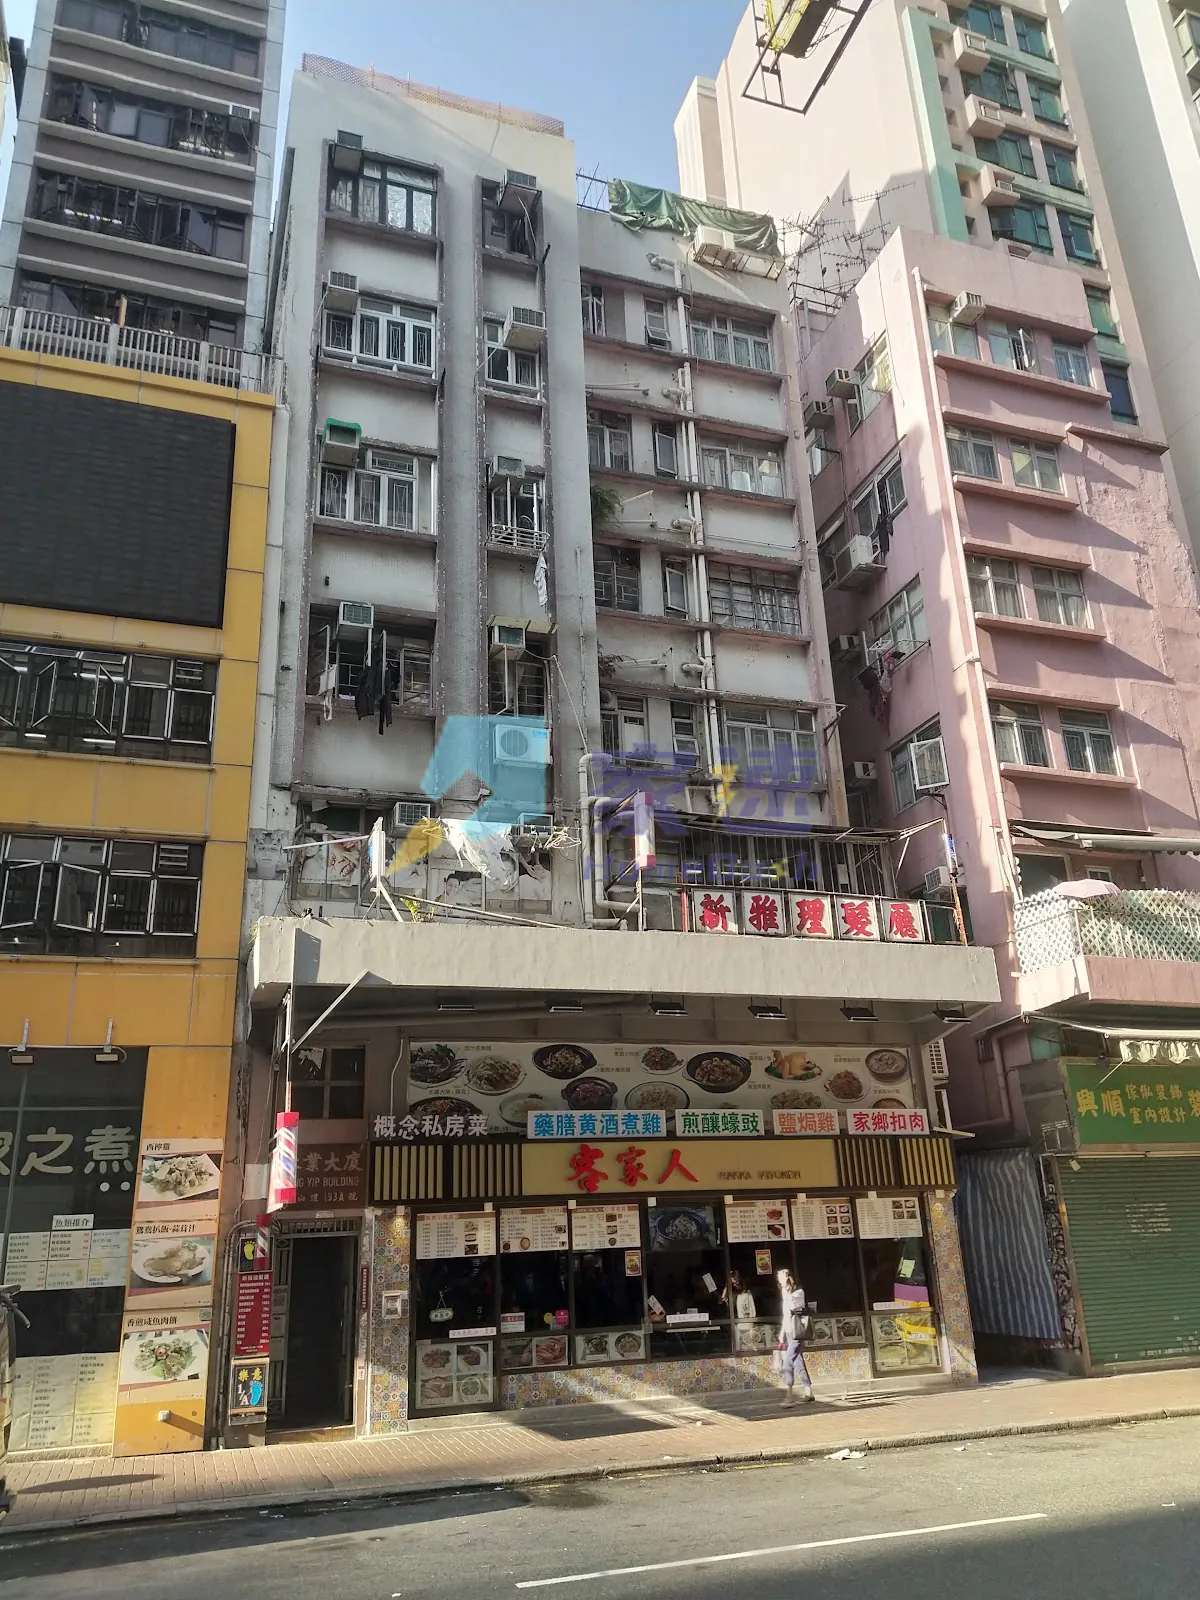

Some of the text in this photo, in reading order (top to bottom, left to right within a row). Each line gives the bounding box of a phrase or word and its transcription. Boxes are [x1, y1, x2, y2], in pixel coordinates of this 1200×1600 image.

[699, 893, 919, 939] 新雅理髮廳
[373, 1113, 489, 1140] 概念私房菜
[681, 1112, 760, 1135] 煎釀蠔豉
[778, 1112, 836, 1134] 鹽焗雞
[853, 1111, 926, 1133] 家鄉扣肉
[1129, 1106, 1187, 1125] 室內設計
[297, 1151, 364, 1172] 業大廈
[568, 1144, 700, 1193] 客家人
[306, 1177, 320, 1188] YIP
[322, 1176, 360, 1188] BUILDING
